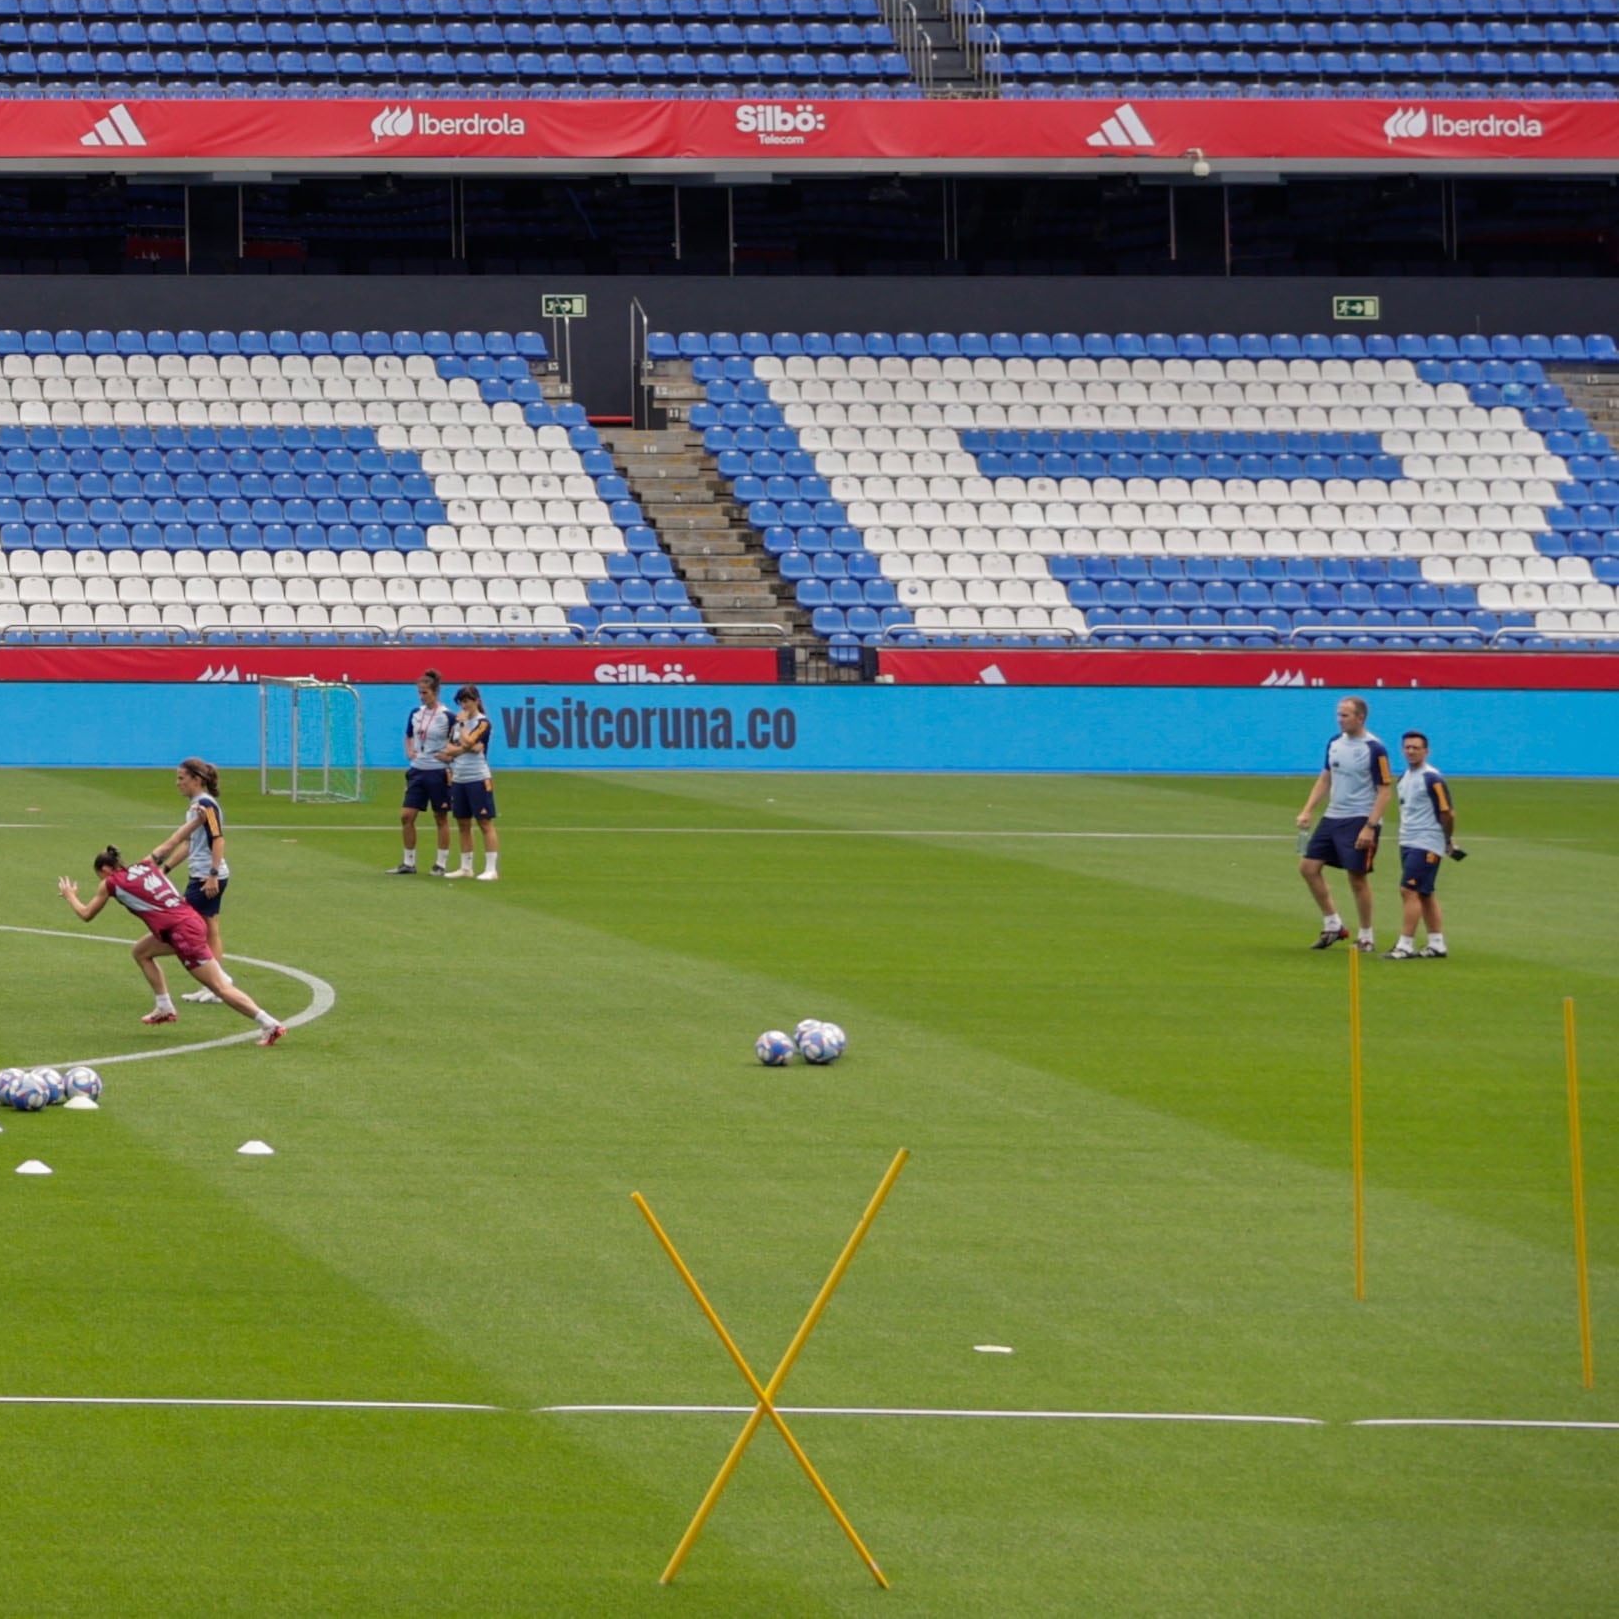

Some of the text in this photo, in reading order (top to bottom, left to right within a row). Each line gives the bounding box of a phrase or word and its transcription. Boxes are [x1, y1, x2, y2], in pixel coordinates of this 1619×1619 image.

[418, 112, 525, 135] Iberdrola
[1432, 114, 1543, 137] Iberdrola
[758, 133, 805, 145] Telecom
[501, 697, 796, 750] visitcoruna.co
